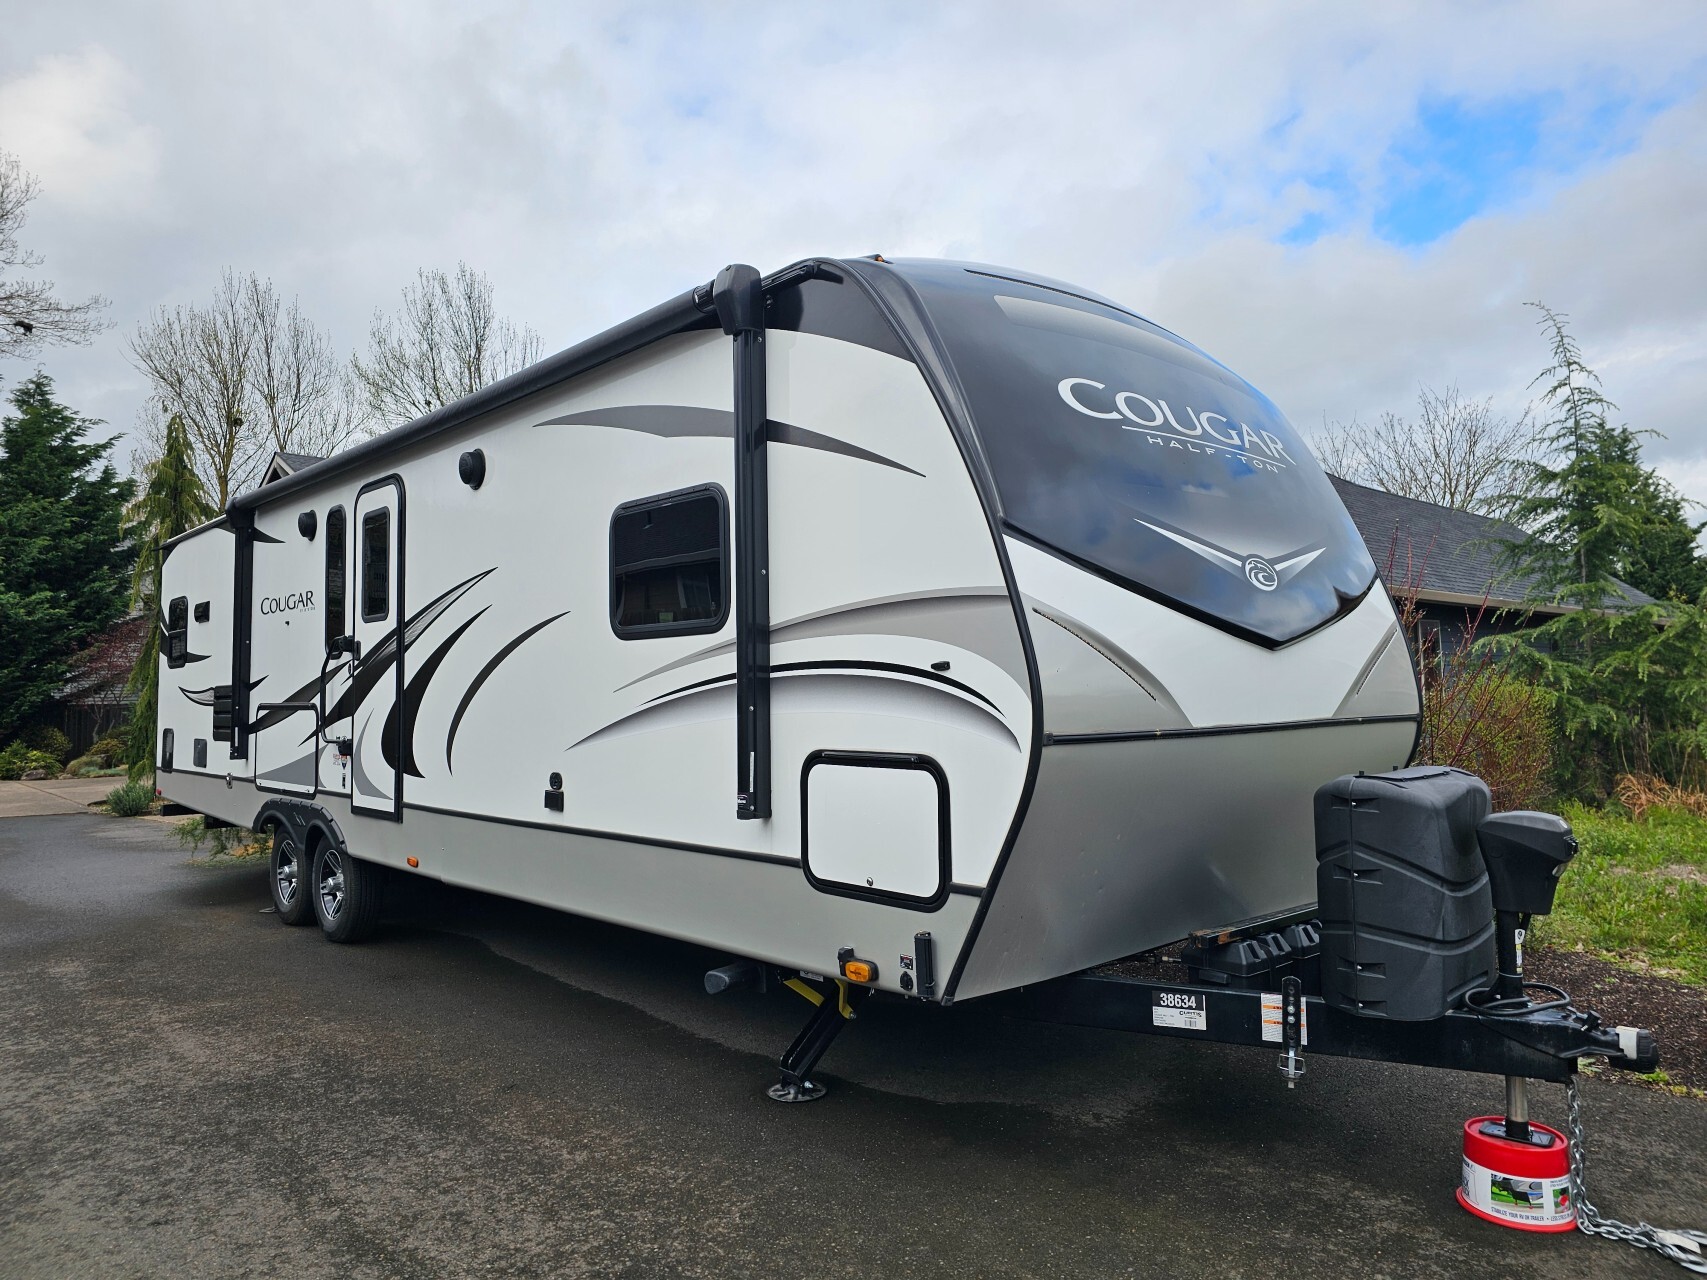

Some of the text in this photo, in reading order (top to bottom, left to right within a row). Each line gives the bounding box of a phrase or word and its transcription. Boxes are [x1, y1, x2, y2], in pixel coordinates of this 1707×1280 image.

[1057, 377, 1297, 466] COUGAR
[260, 590, 315, 615] COUGAR
[1160, 992, 1197, 1009] 38634
